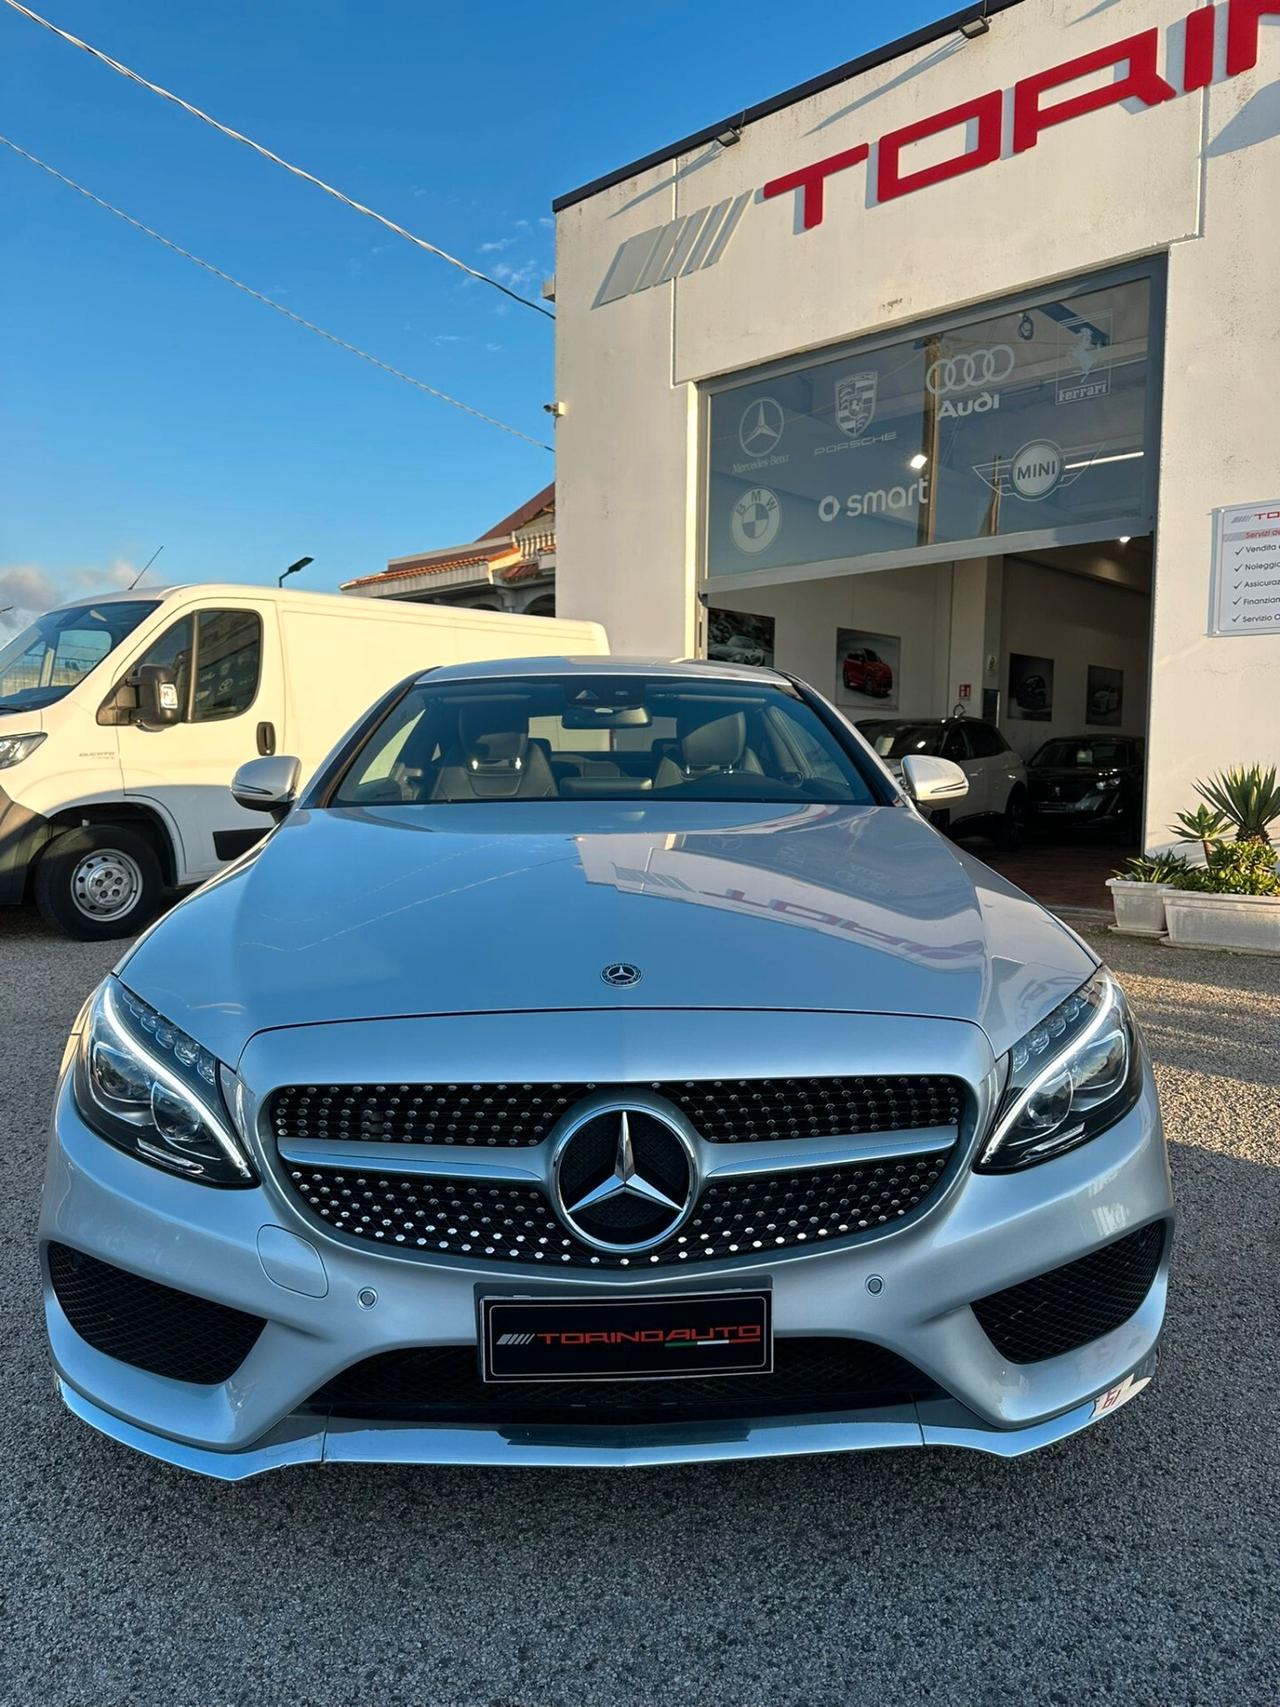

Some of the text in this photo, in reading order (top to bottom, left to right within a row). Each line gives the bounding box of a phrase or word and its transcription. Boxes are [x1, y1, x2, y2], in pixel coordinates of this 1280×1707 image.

[1057, 381, 1107, 402] Ferrari
[937, 392, 1000, 420] Audi
[814, 431, 897, 456] PORSCHE
[1017, 461, 1056, 481] MINI
[736, 490, 777, 515] BMW
[846, 475, 929, 517] smart
[1254, 511, 1280, 520] TO
[1246, 530, 1271, 539] Servizi
[1242, 614, 1272, 622] Servizio
[537, 1325, 760, 1344] TORINOAUTO
